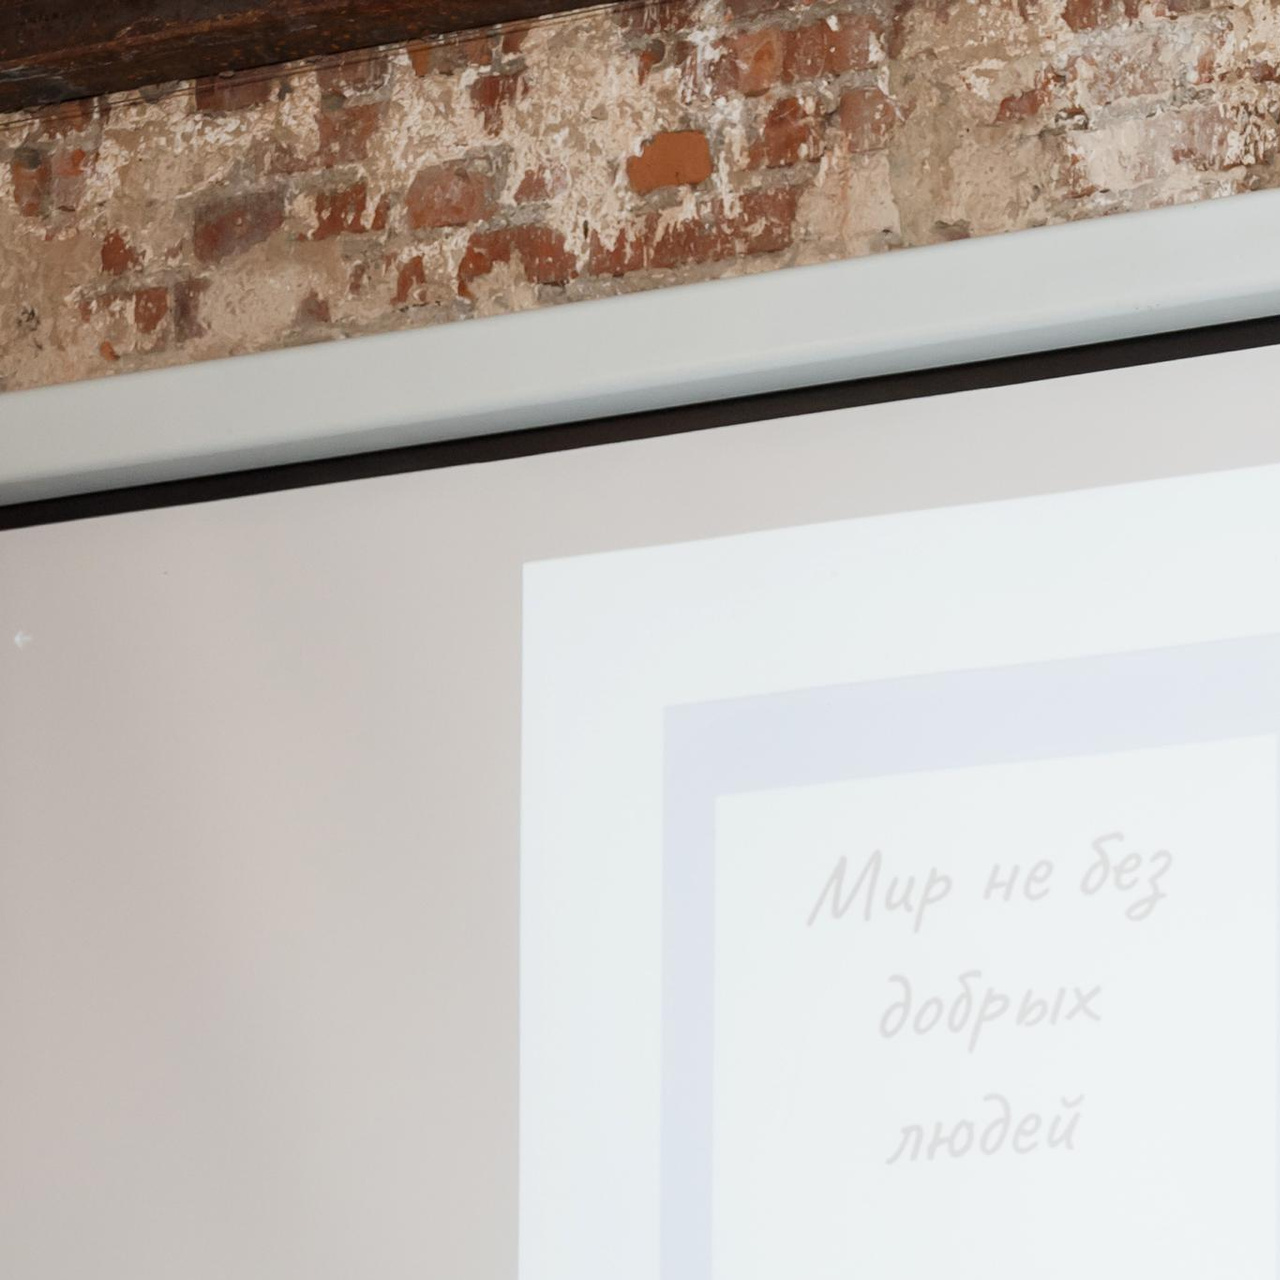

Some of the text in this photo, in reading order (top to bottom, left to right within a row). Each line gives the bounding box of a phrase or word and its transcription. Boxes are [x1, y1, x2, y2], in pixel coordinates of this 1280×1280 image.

[806, 831, 1174, 934] Мир не без
[878, 969, 1103, 1054] добрых
[885, 1093, 1085, 1165] людей
